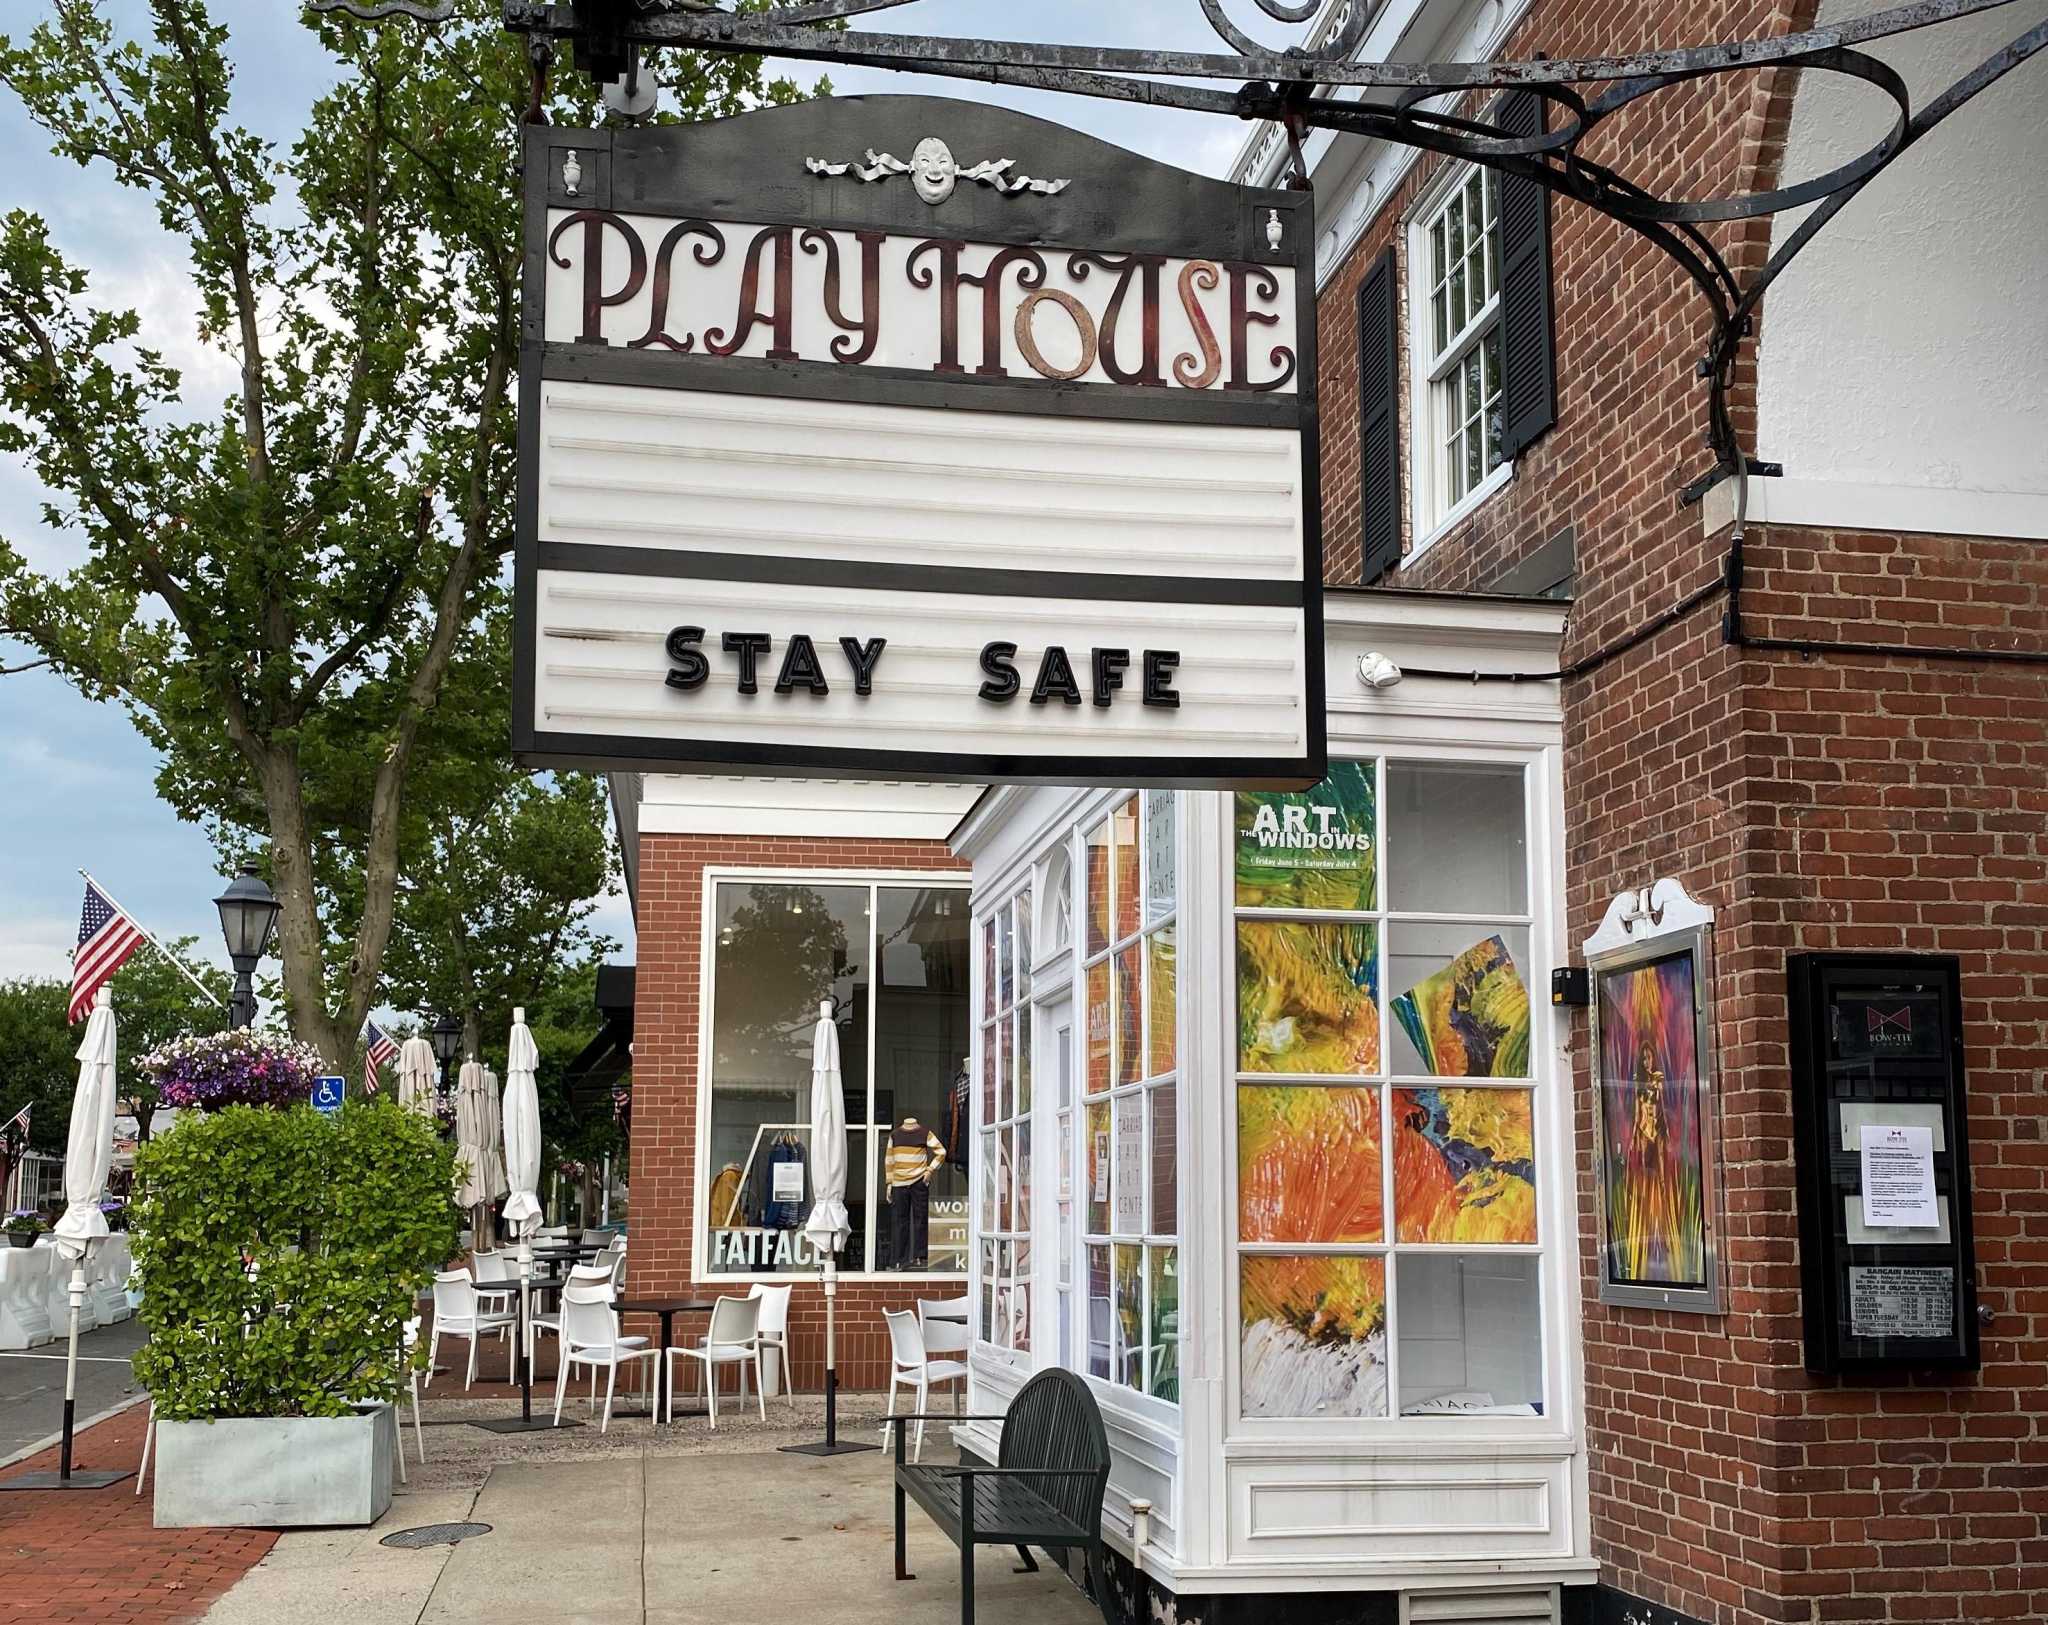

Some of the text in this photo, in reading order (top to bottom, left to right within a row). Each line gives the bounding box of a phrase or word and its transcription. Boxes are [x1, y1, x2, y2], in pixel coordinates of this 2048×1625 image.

[548, 209, 1297, 392] PLAYHOUSE
[664, 625, 1182, 709] STAY SAFE
[1241, 830, 1371, 850] THE WINDOWS
[1253, 804, 1336, 833] ART
